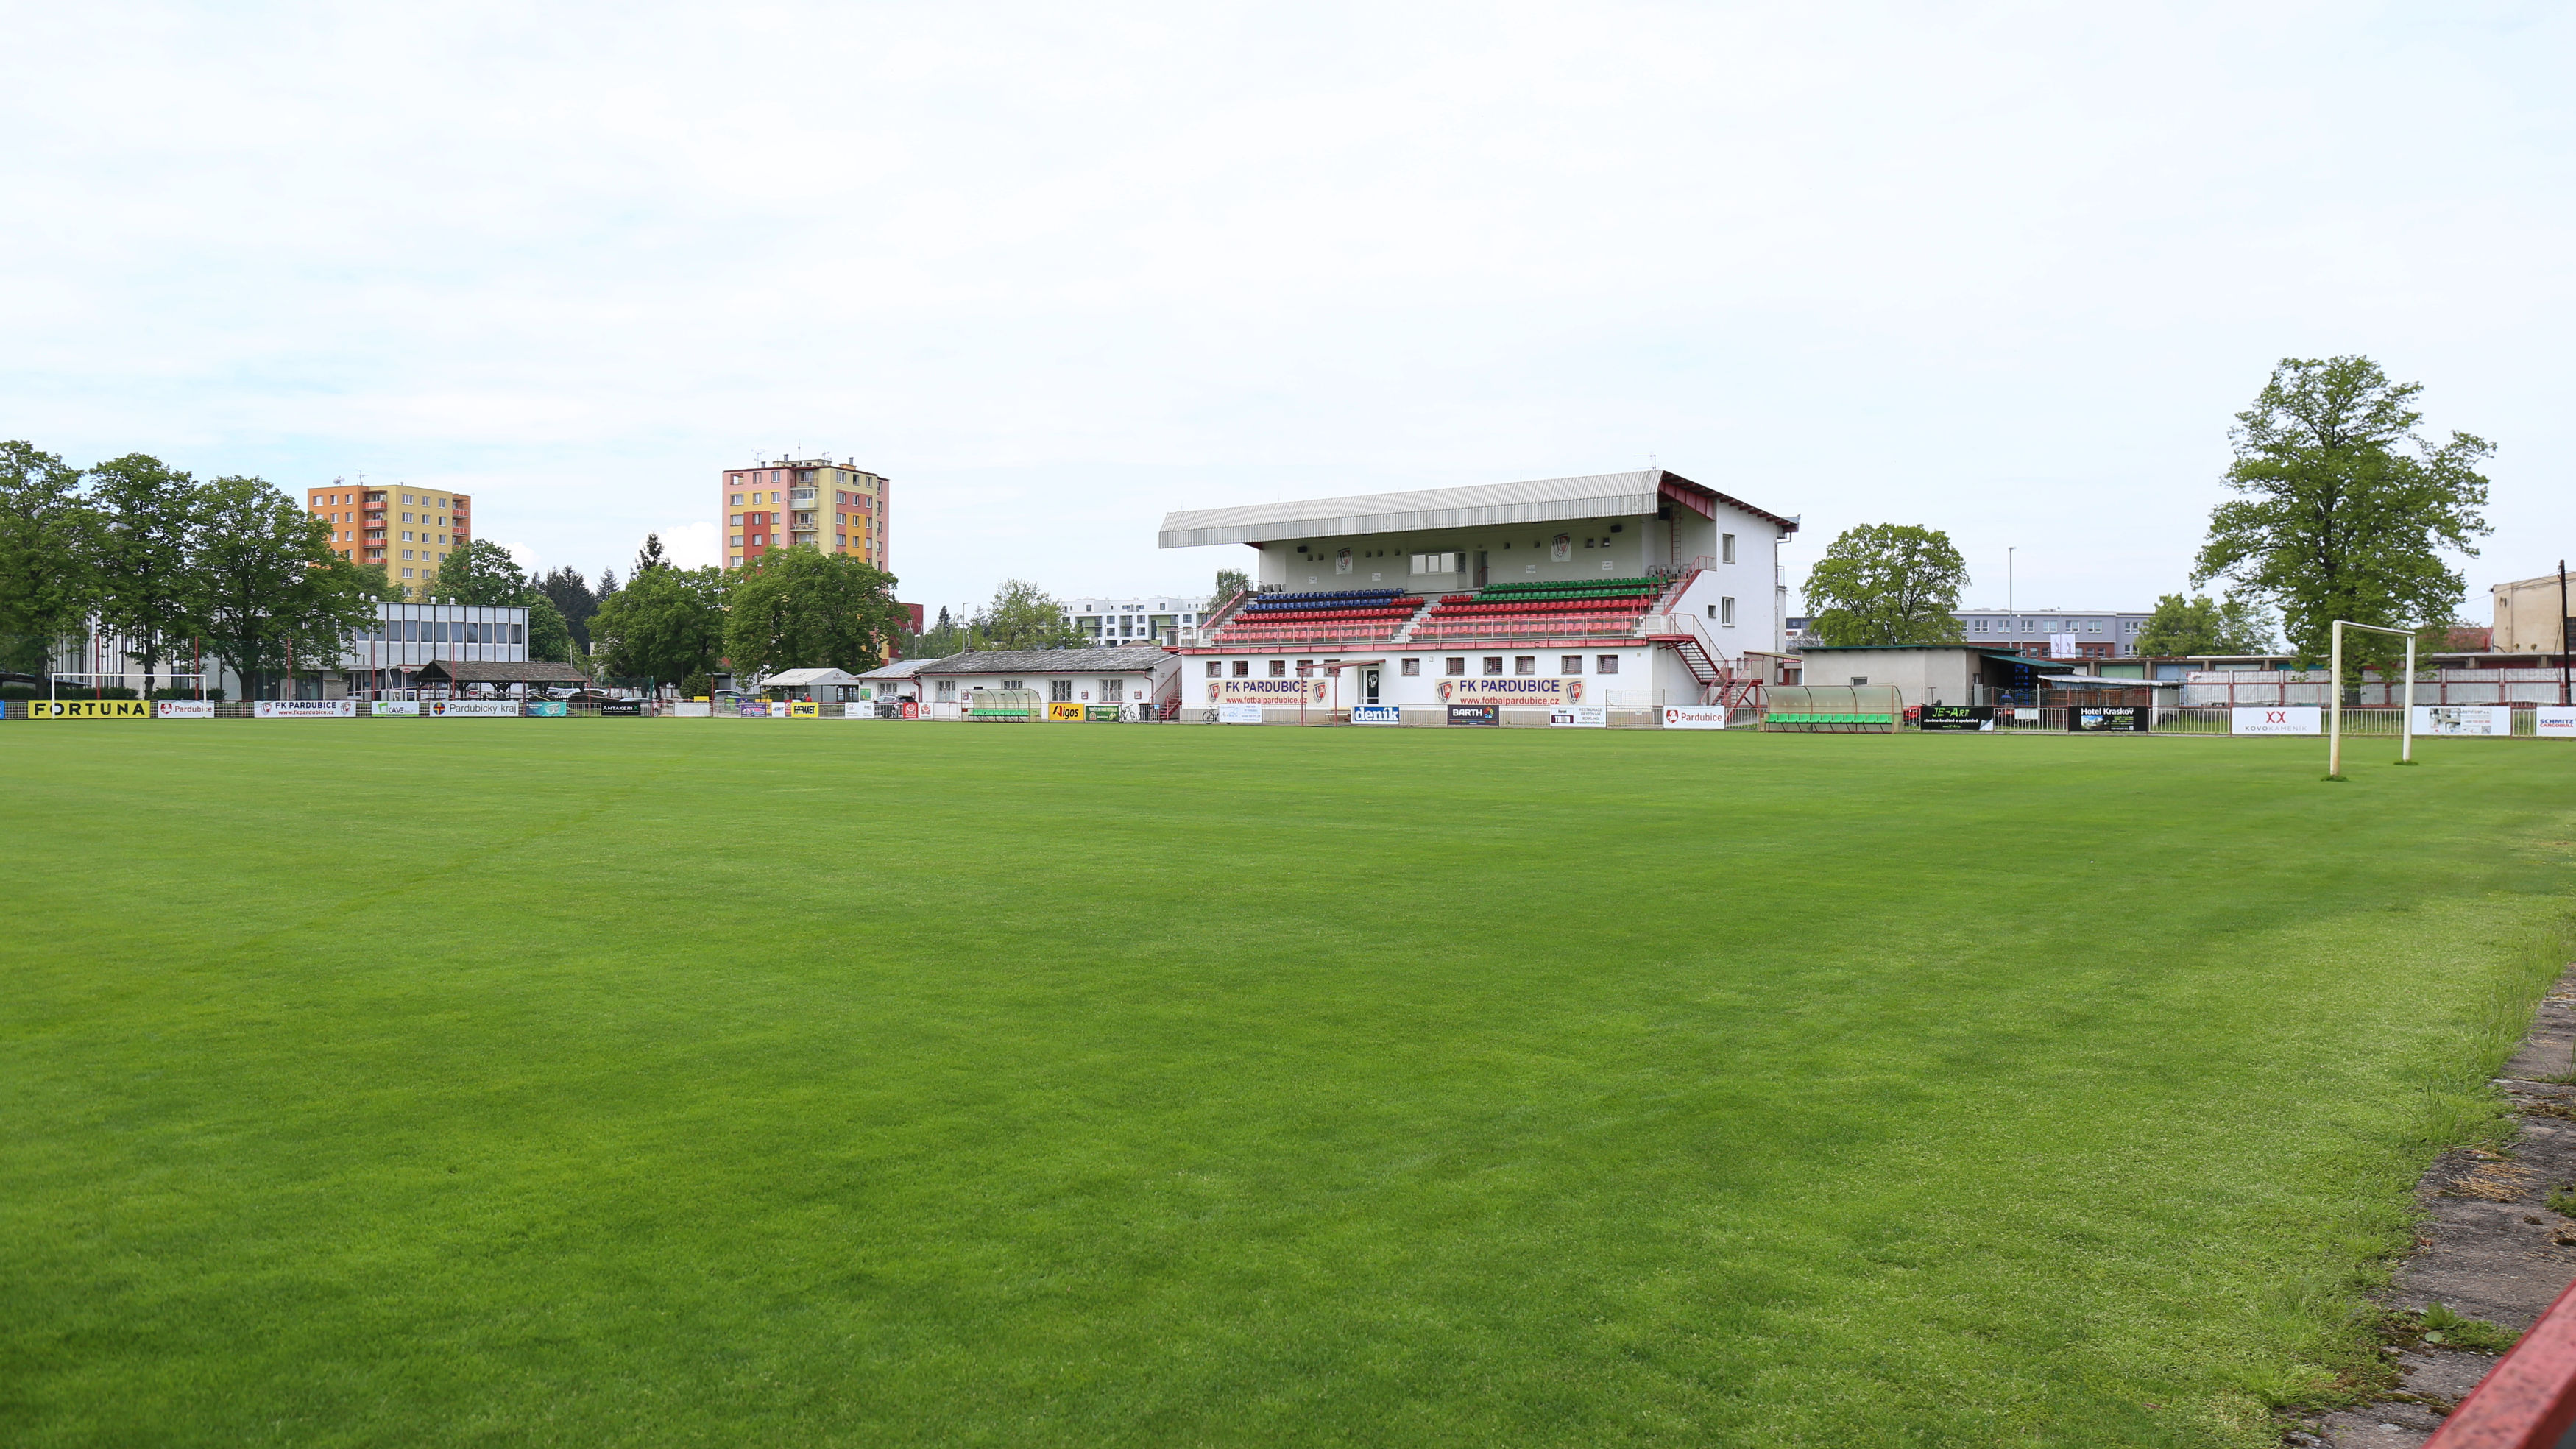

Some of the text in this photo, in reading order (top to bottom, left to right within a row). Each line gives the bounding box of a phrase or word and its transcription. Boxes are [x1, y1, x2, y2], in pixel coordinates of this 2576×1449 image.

[1225, 681, 1308, 692] FK PARDUBICE
[1460, 680, 1560, 692] FK PARDUBICE
[1226, 696, 1308, 704] www.fotbalpardubice.cz
[1460, 696, 1560, 706] www.fotbalpardubice.cz
[35, 703, 145, 716] FORTUNA
[449, 704, 517, 714] Pardubický kraj
[1052, 705, 1079, 719] Aigos
[1355, 707, 1399, 721] deník
[2081, 707, 2134, 715] Hotel Kraskov
[1681, 712, 1722, 721] Pardubice
